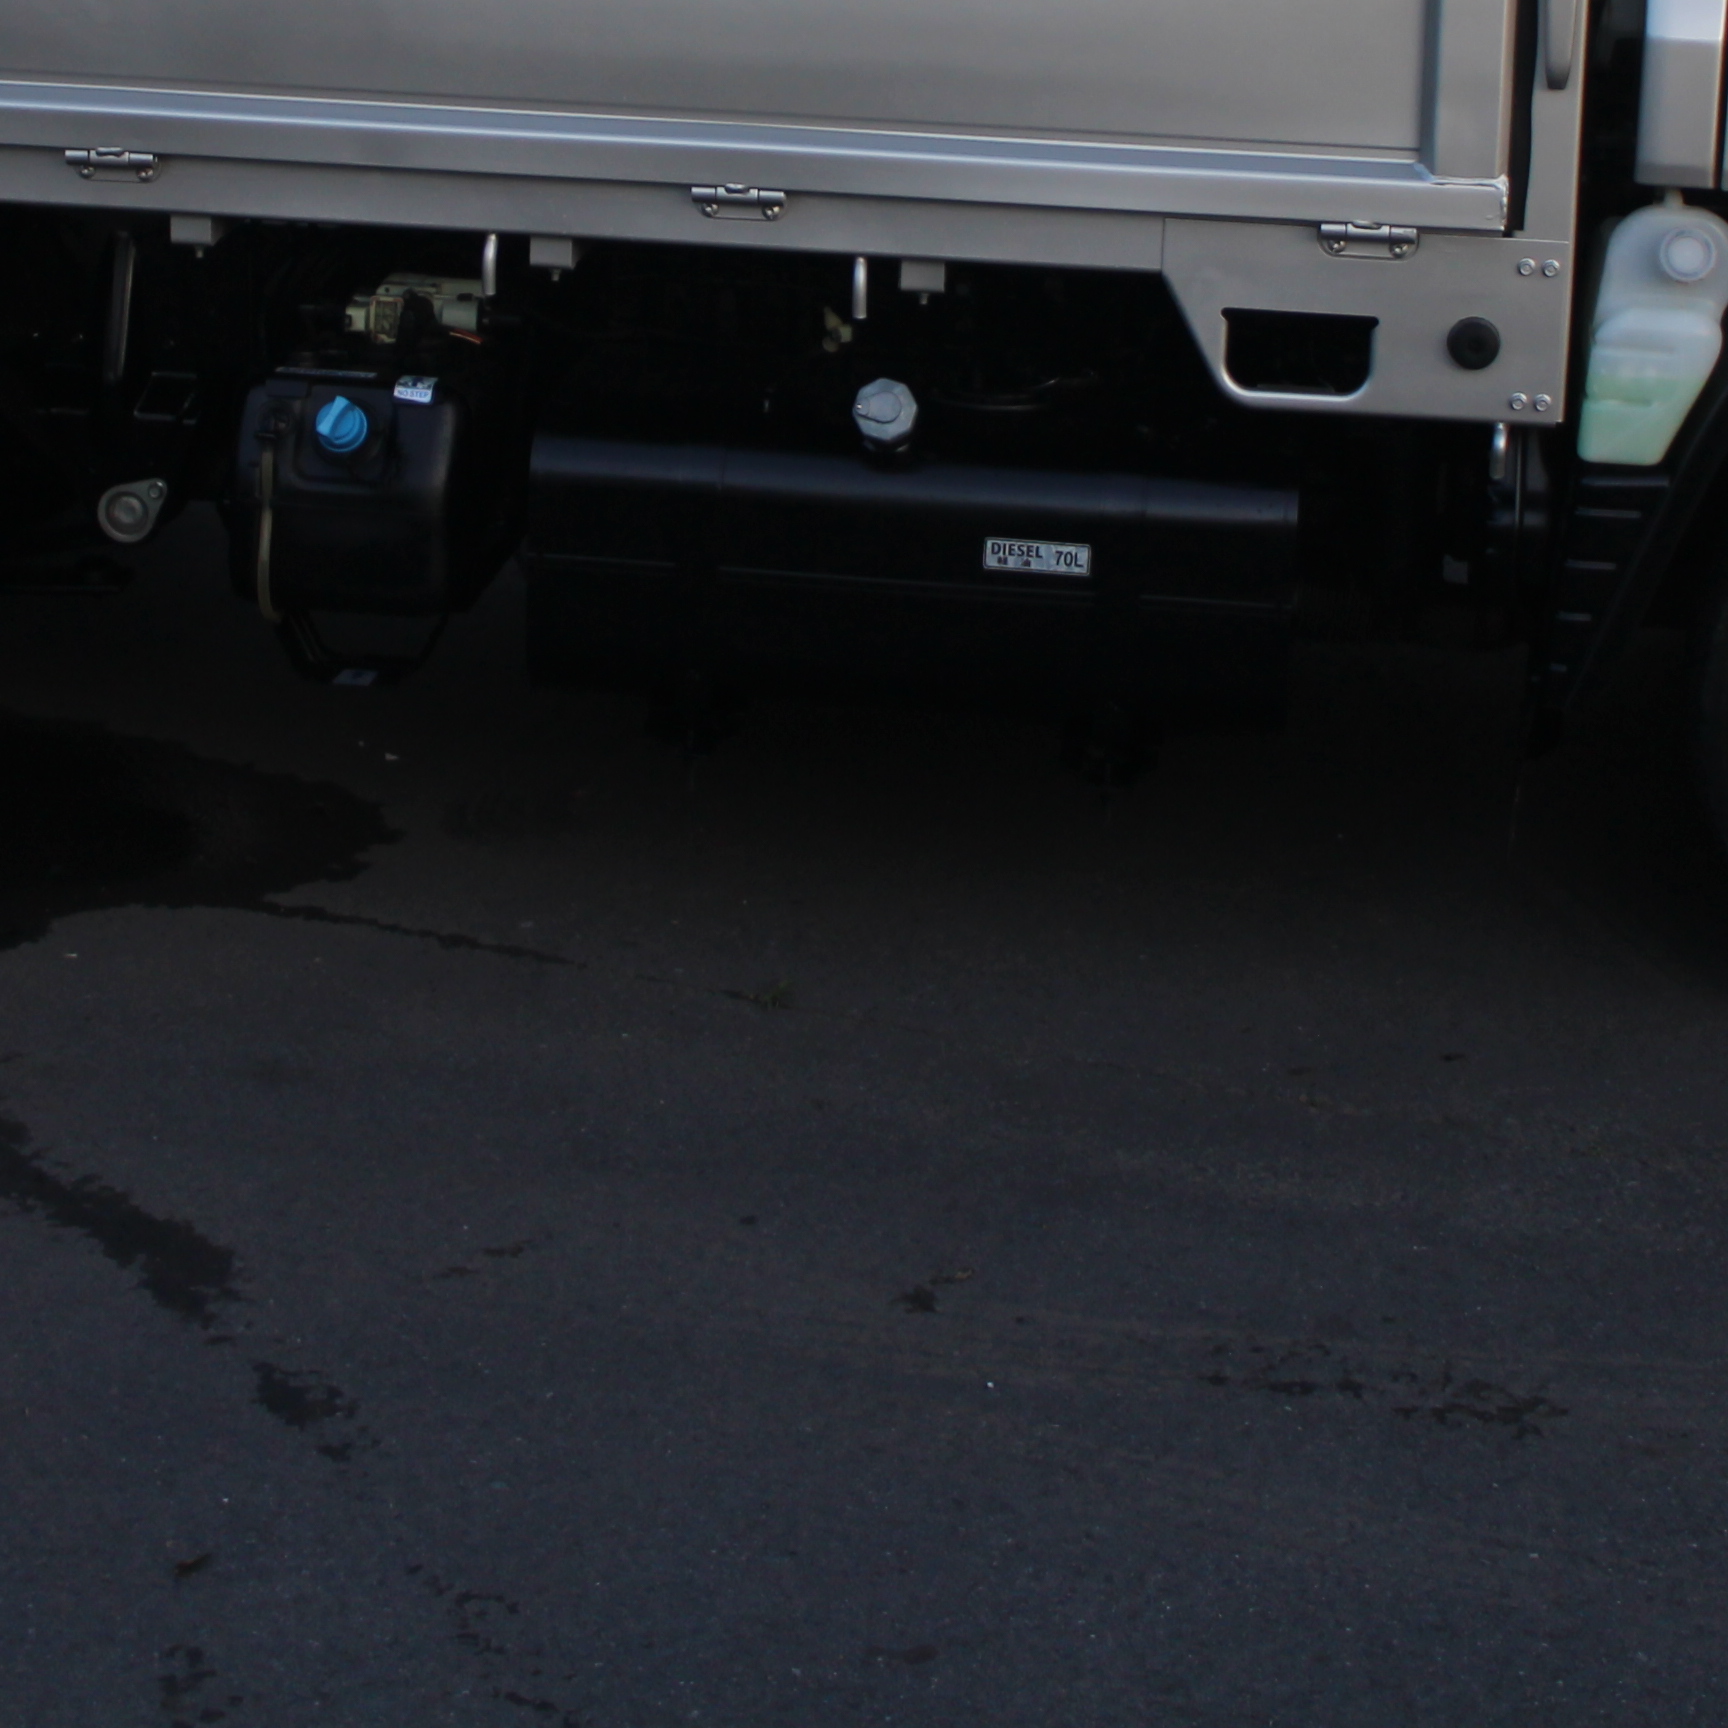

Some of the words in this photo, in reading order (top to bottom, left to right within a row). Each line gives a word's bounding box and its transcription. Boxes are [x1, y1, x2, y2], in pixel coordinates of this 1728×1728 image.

[410, 390, 429, 399] STEP
[991, 542, 1043, 559] DIESEL
[1054, 550, 1085, 569] 70L
